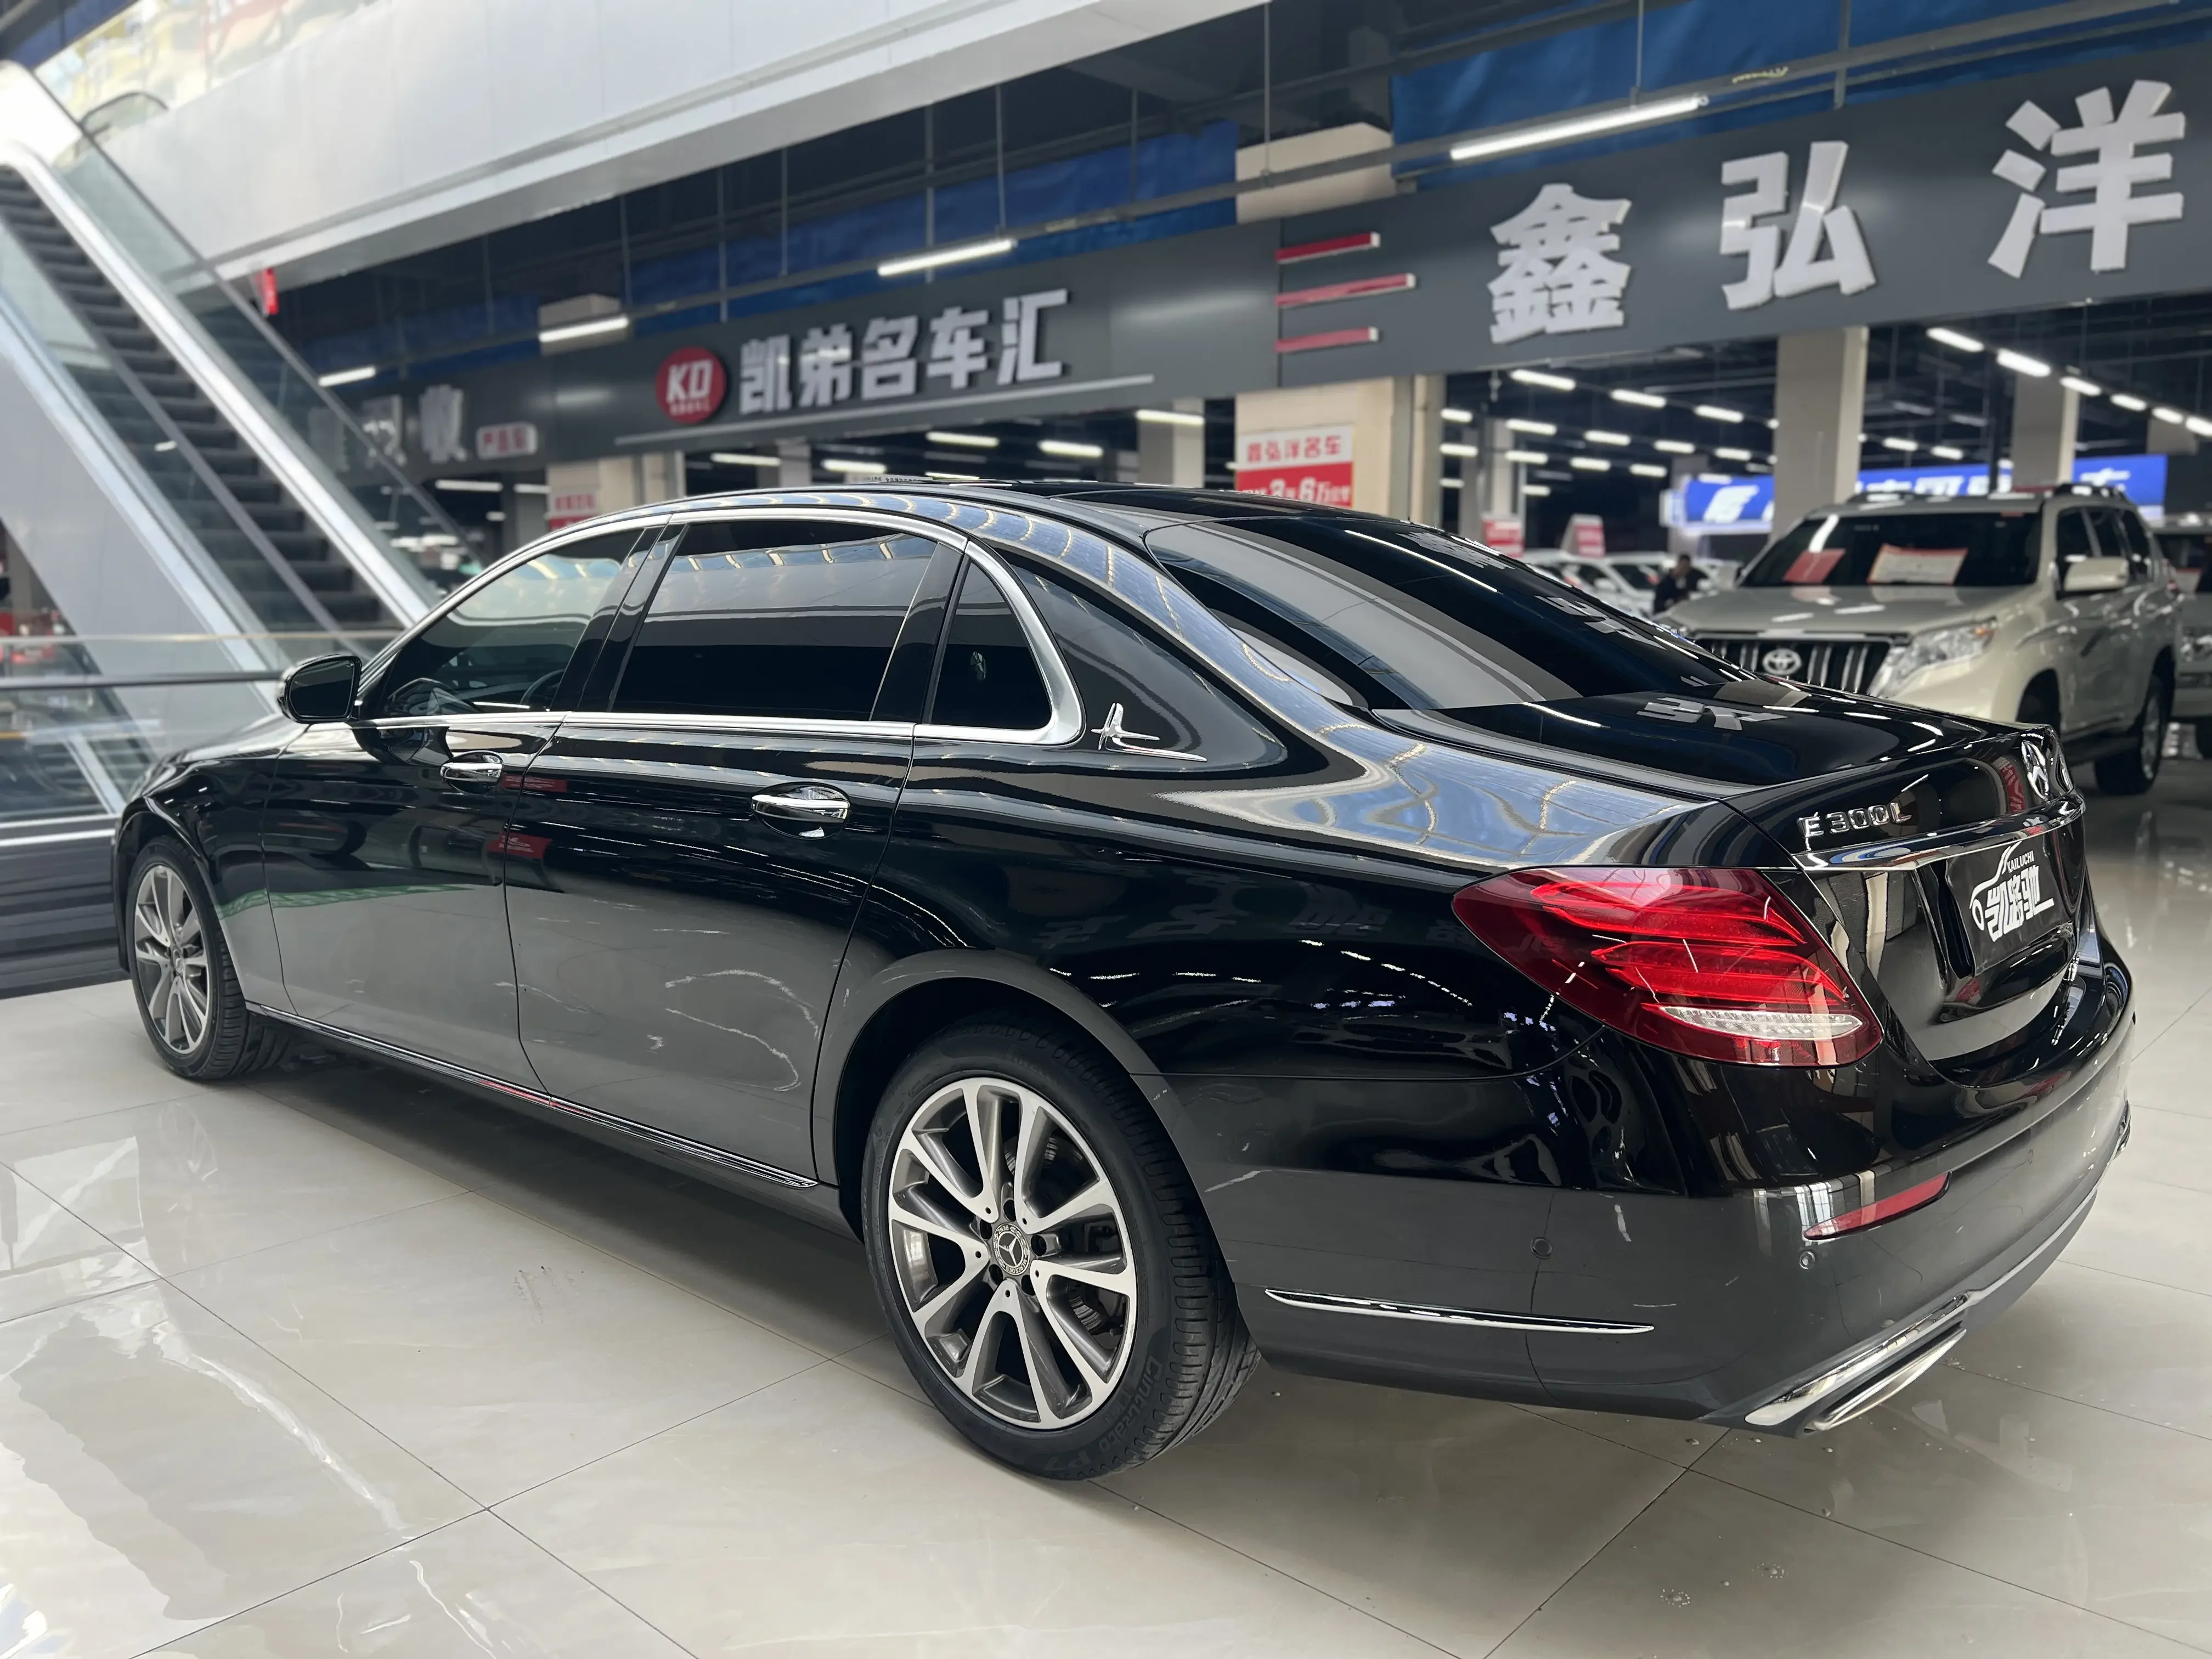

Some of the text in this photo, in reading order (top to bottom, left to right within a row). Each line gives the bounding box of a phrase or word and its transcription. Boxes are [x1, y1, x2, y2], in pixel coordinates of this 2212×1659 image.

[1488, 80, 2185, 343] 鑫弘洋
[739, 288, 1069, 415] 凯弟名车汇
[665, 359, 713, 404] KD
[2006, 850, 2035, 873] KAILUCHI
[997, 1224, 1009, 1234] BENZ
[1005, 1258, 1028, 1274] MERCEDES
